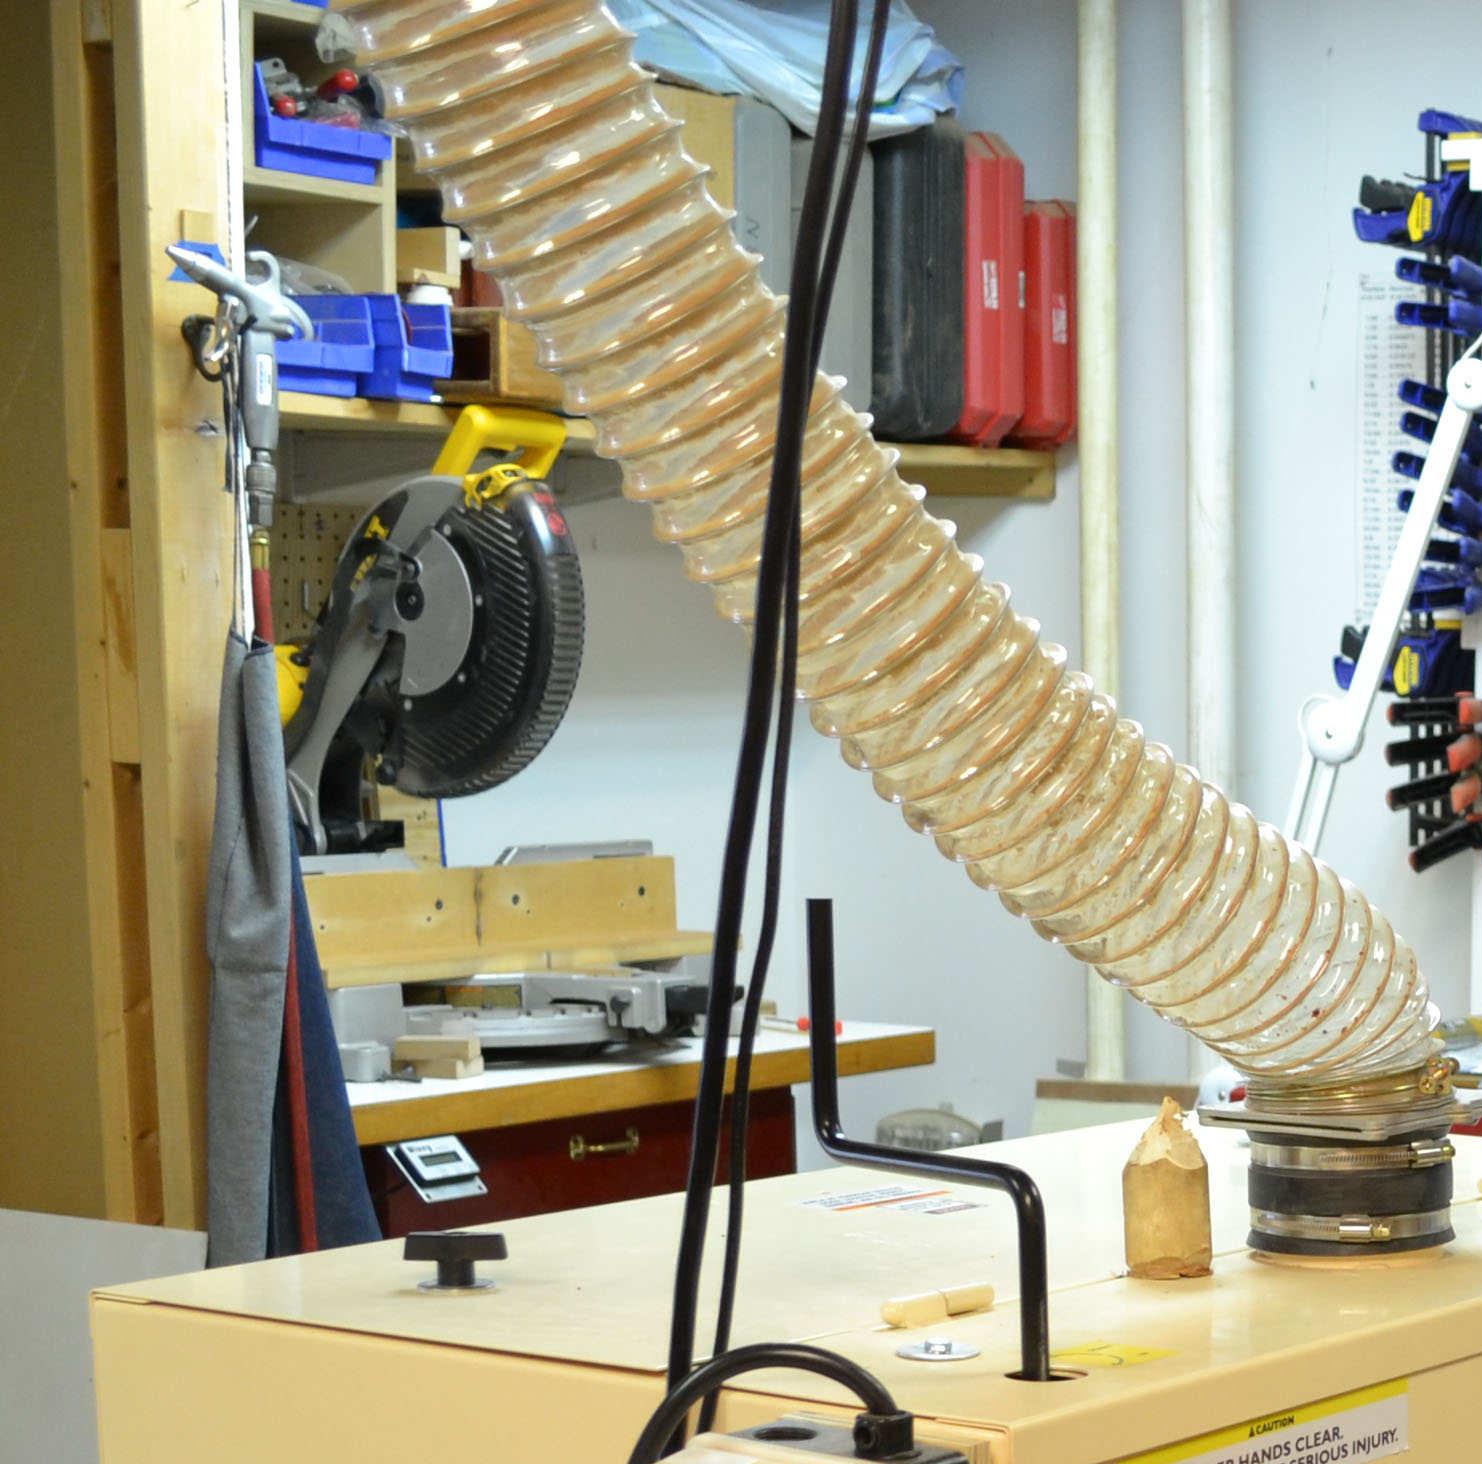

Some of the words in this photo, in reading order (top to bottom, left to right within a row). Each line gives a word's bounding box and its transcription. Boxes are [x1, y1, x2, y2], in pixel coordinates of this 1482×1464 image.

[1256, 1415, 1295, 1436] CAUTION
[1295, 1426, 1344, 1453] CLEAR.
[1351, 1428, 1399, 1456] INJURY.
